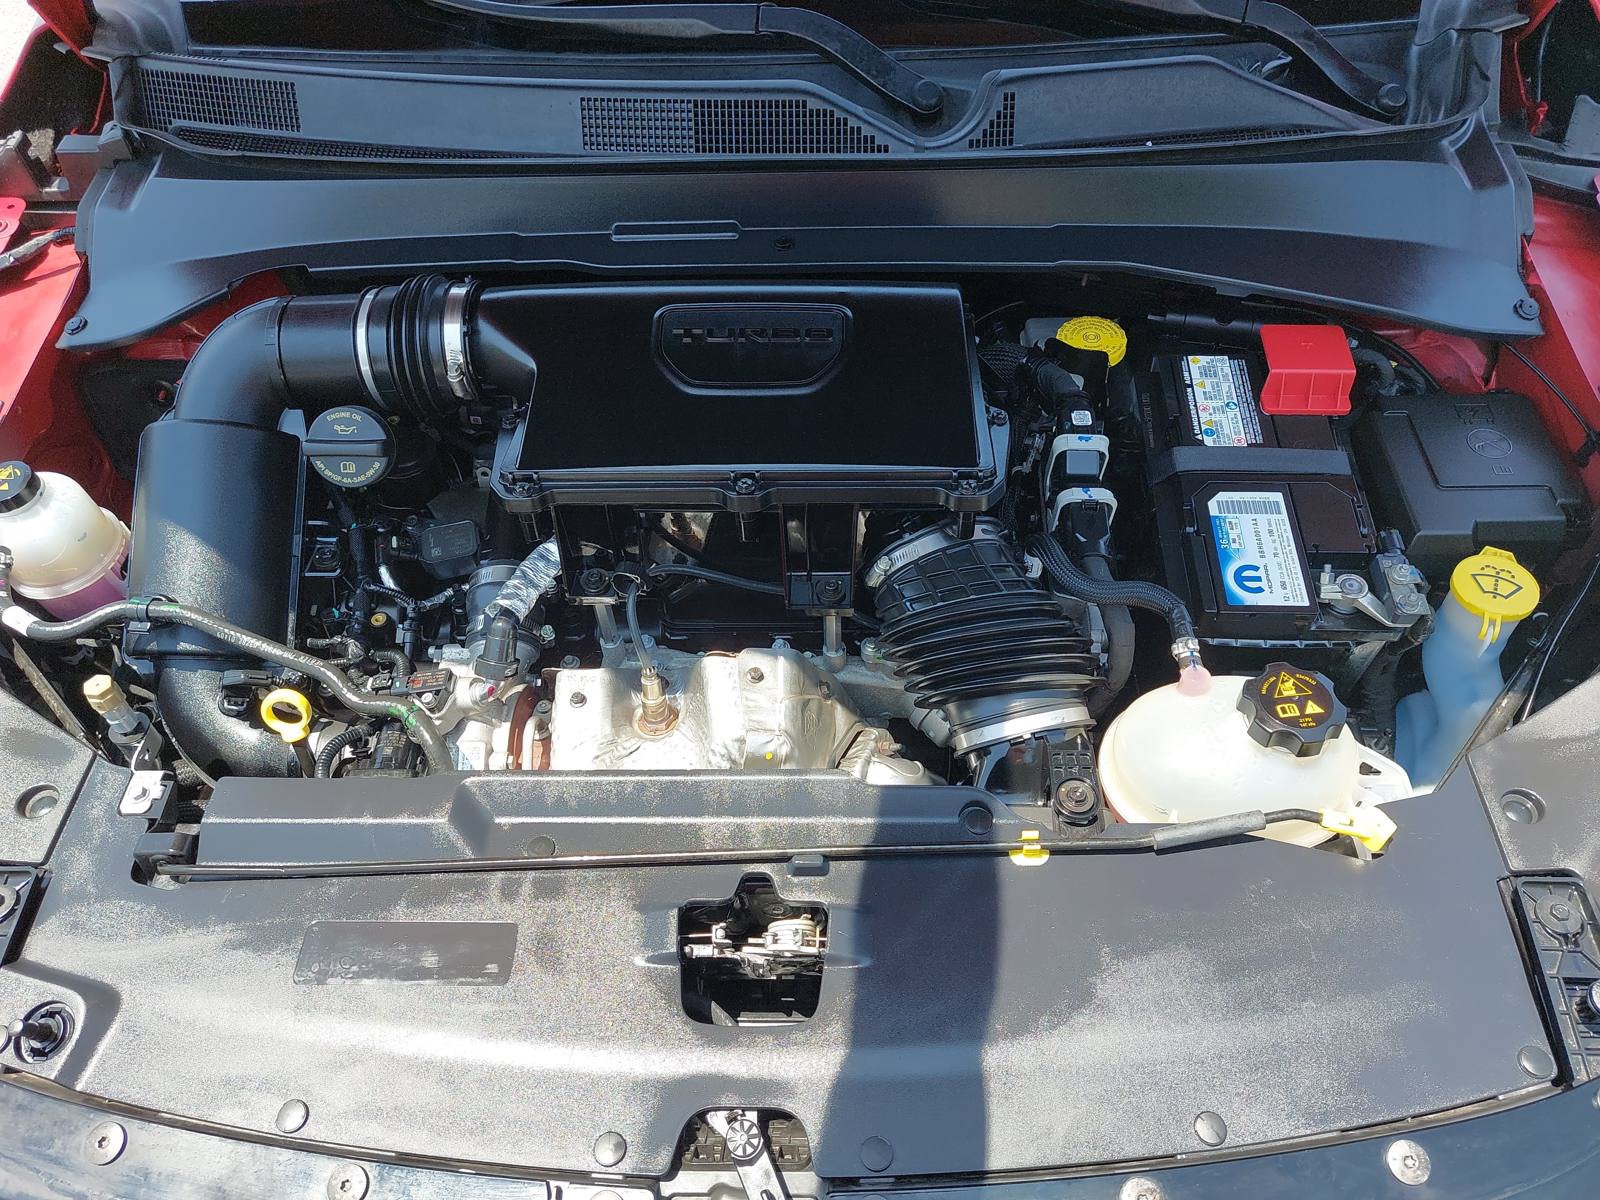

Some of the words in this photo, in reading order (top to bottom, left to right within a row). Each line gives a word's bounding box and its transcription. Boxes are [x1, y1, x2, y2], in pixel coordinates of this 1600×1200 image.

[672, 327, 834, 344] TURBO
[1183, 371, 1192, 385] AGM
[326, 411, 351, 422] ENGINE
[351, 412, 363, 422] OIL
[315, 460, 325, 471] API
[1219, 539, 1230, 550] 36
[1273, 551, 1281, 559] 70
[1264, 564, 1275, 594] MOPAR
[1279, 580, 1288, 591] 650
